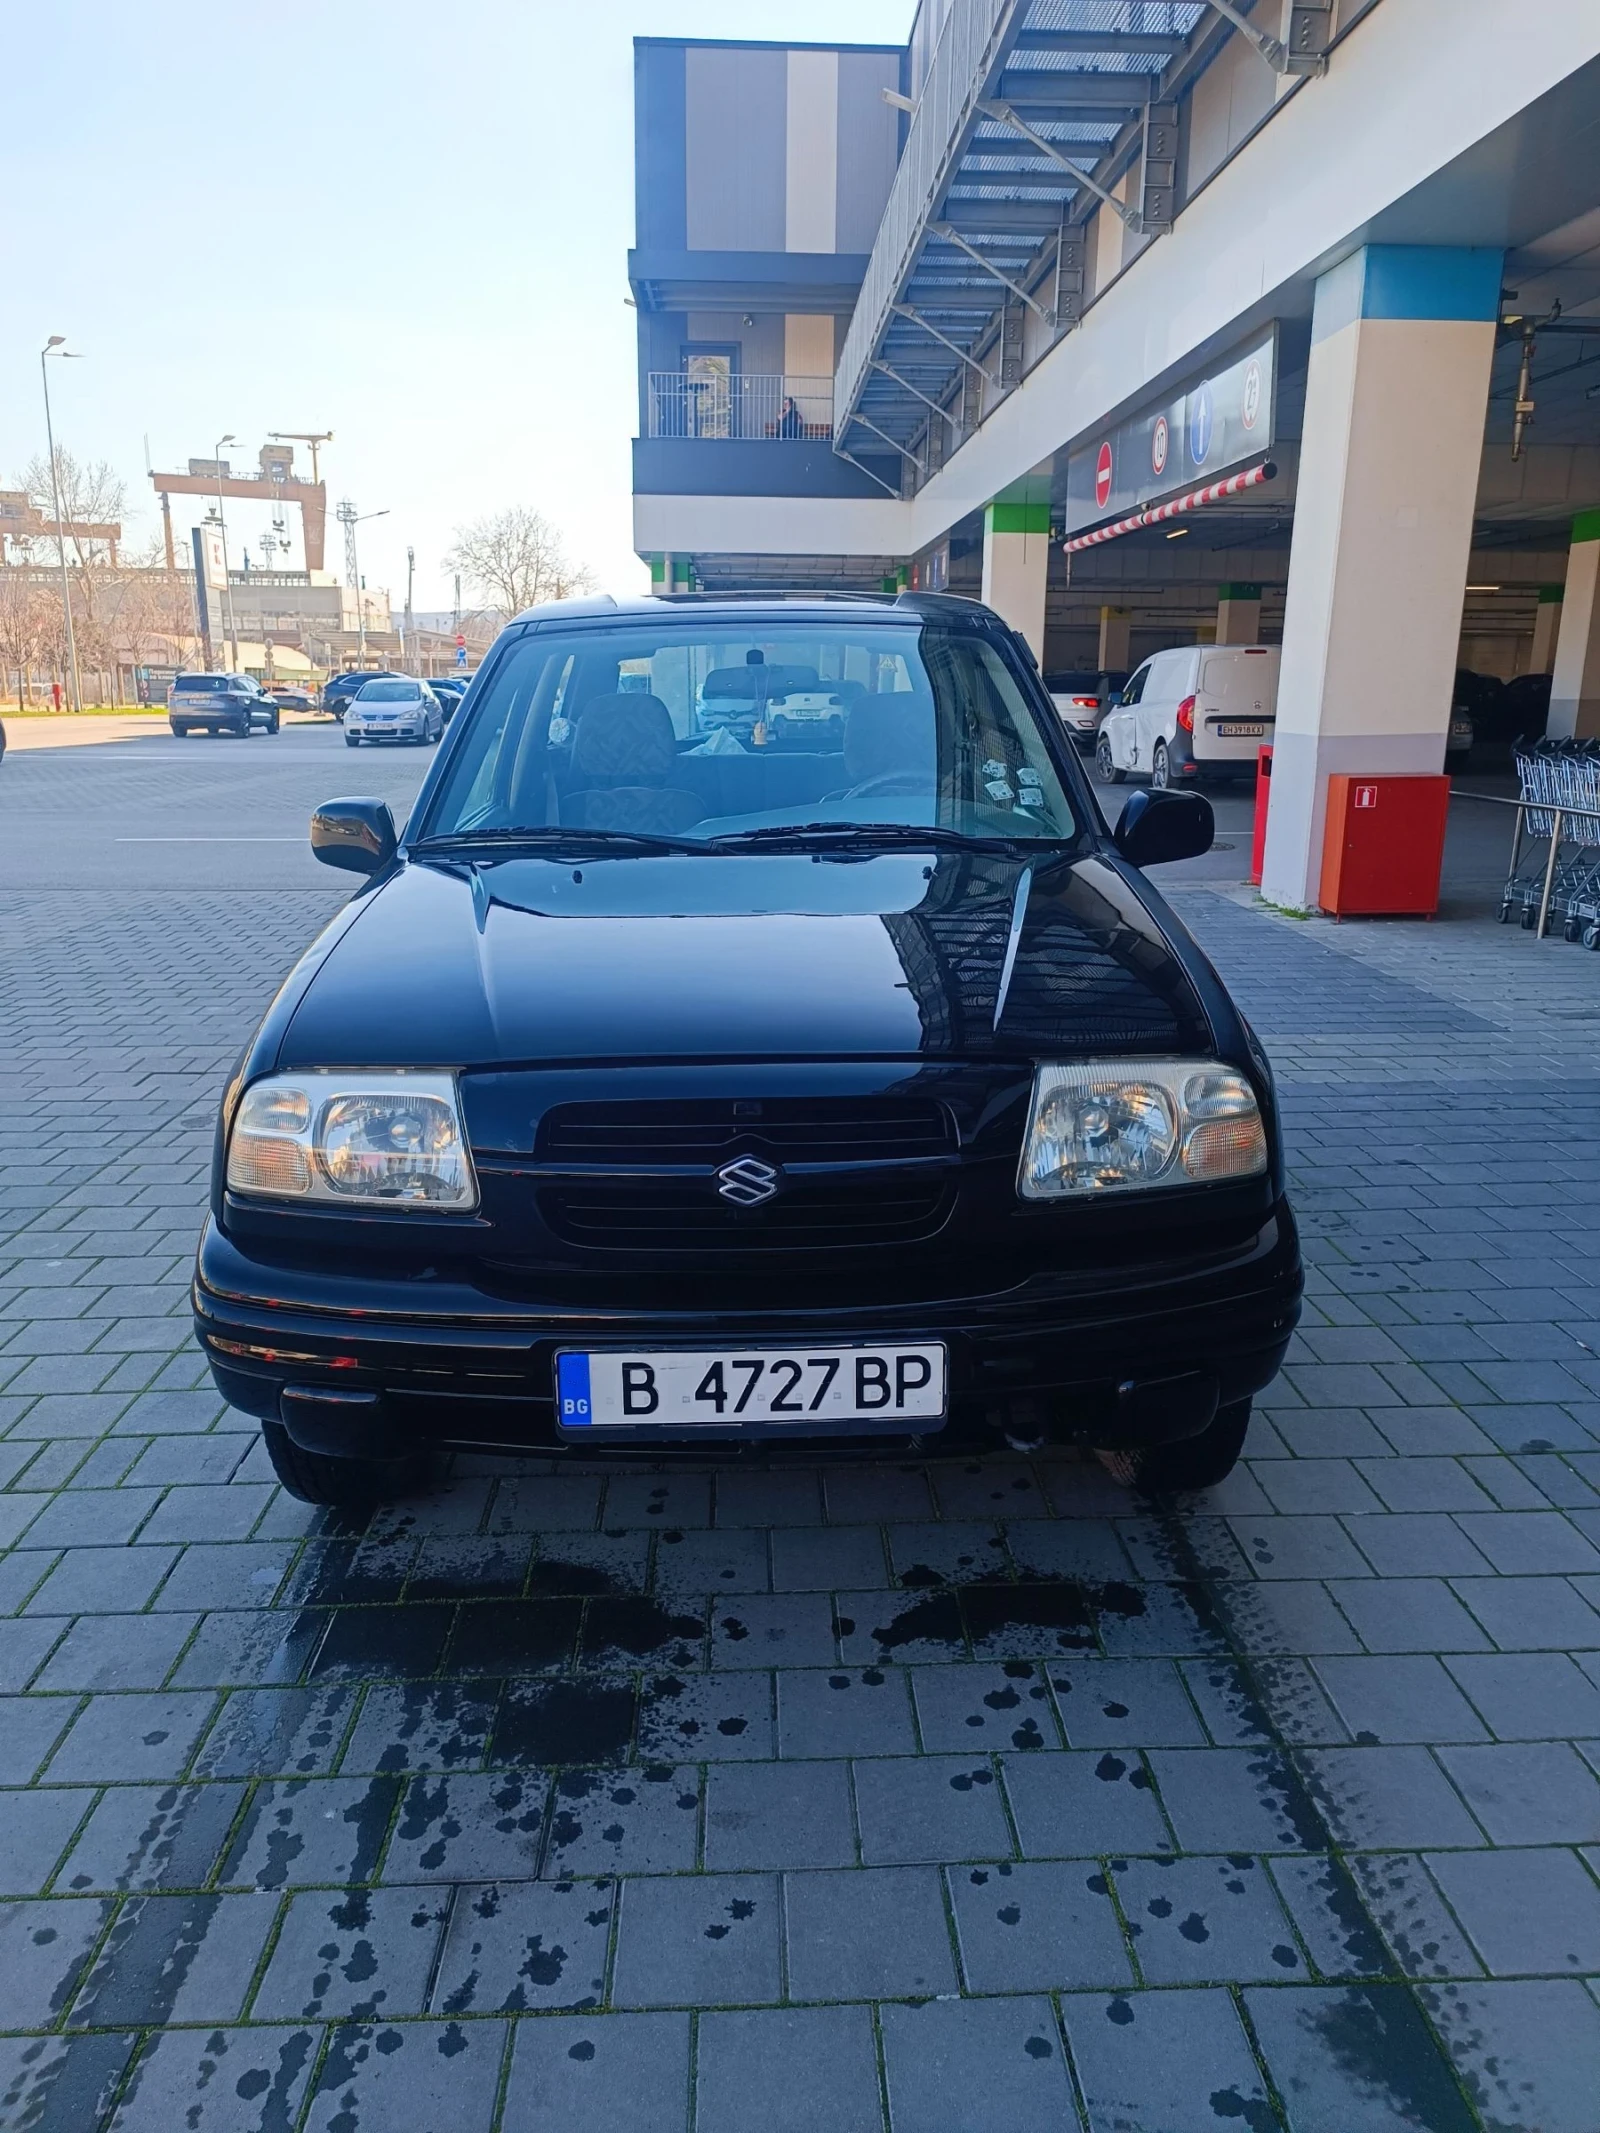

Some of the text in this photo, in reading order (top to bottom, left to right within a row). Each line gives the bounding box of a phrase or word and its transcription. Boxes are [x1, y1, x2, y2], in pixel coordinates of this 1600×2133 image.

[1157, 431, 1165, 460] 10
[621, 1354, 932, 1415] B 4727 BP
[563, 1398, 588, 1415] BG
